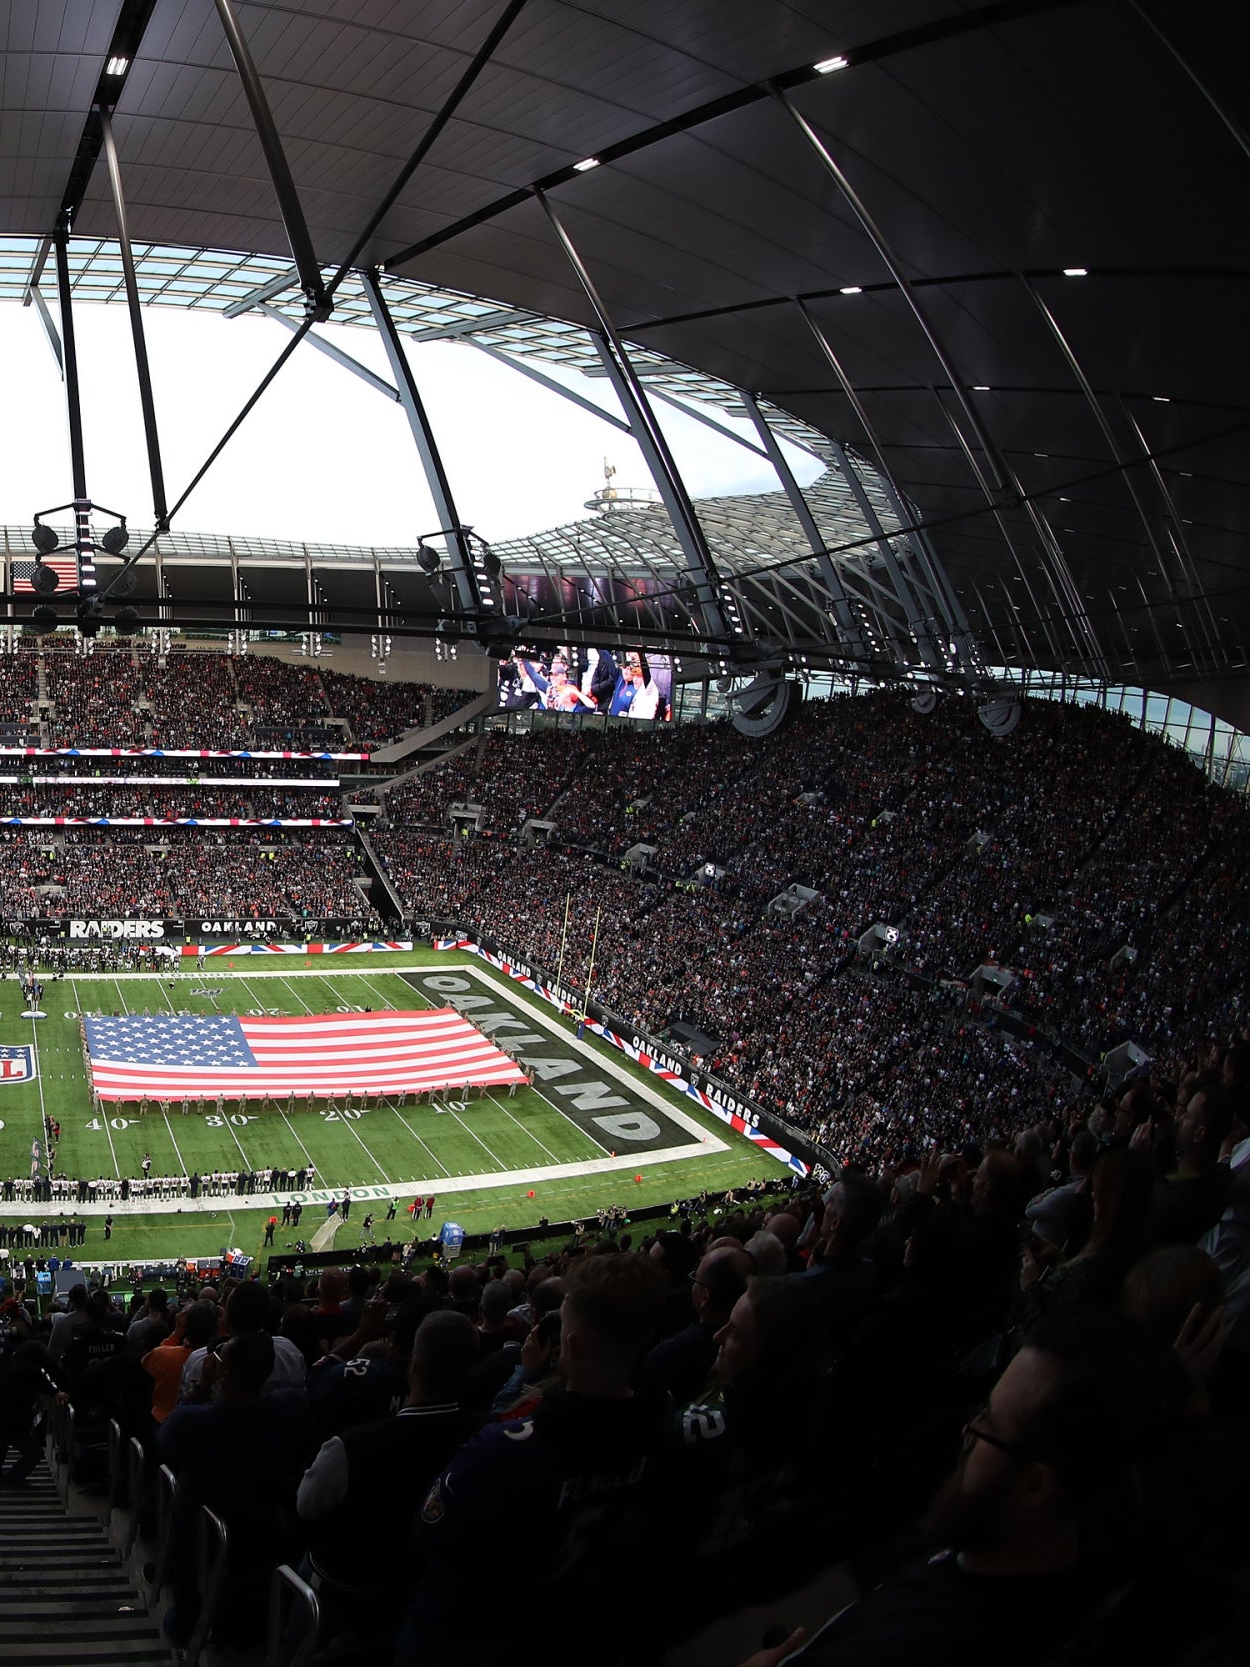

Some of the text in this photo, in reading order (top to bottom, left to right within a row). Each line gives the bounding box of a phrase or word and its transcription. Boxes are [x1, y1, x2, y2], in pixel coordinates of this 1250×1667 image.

[70, 920, 164, 938] RAIDERS
[201, 921, 277, 932] OAKLAND
[497, 950, 531, 977] OAKLAND
[422, 975, 661, 1141] OAKLAND
[632, 1035, 760, 1128] OAKLAND RAIDERS
[319, 1108, 363, 1122] 20
[428, 1100, 466, 1114] 10
[85, 1117, 130, 1131] 40
[205, 1114, 249, 1127] 30
[273, 1186, 391, 1205] LONDON
